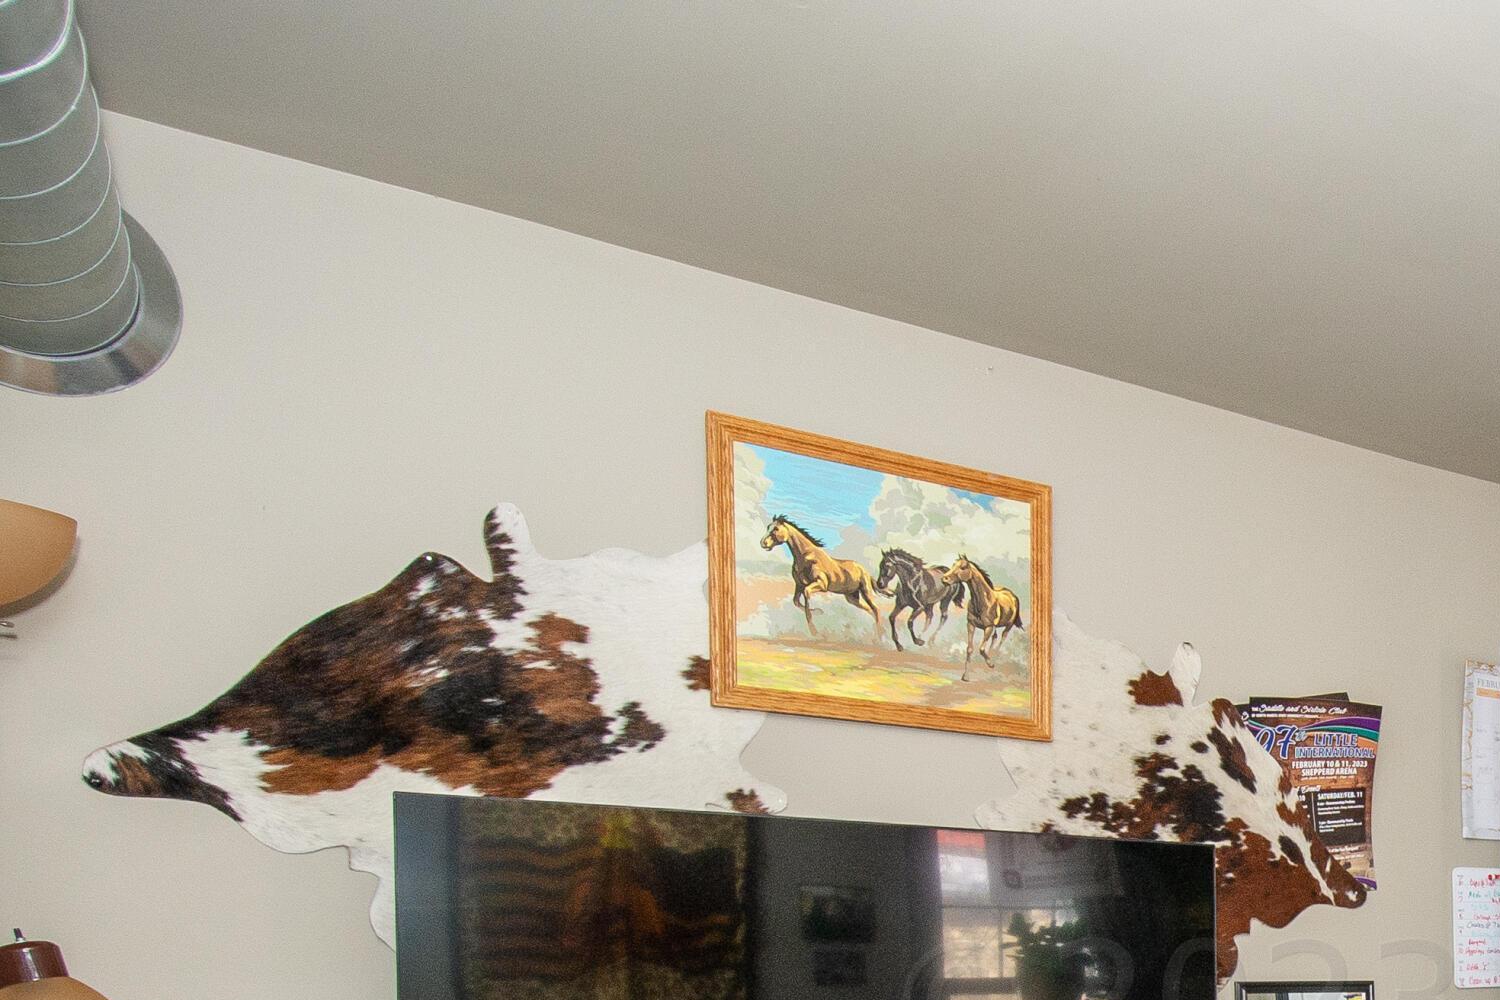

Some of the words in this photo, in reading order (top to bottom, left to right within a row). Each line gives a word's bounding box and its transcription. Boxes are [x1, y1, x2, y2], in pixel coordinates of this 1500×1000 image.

[1313, 733, 1358, 746] LITTLE
[1295, 746, 1375, 759] INTERNATIONAL
[1291, 760, 1326, 769] FEBRUARY
[1326, 760, 1335, 768] 10
[1352, 760, 1367, 768] 2023
[1301, 768, 1335, 777] SHEPPERD
[1335, 767, 1357, 775] ARENA
